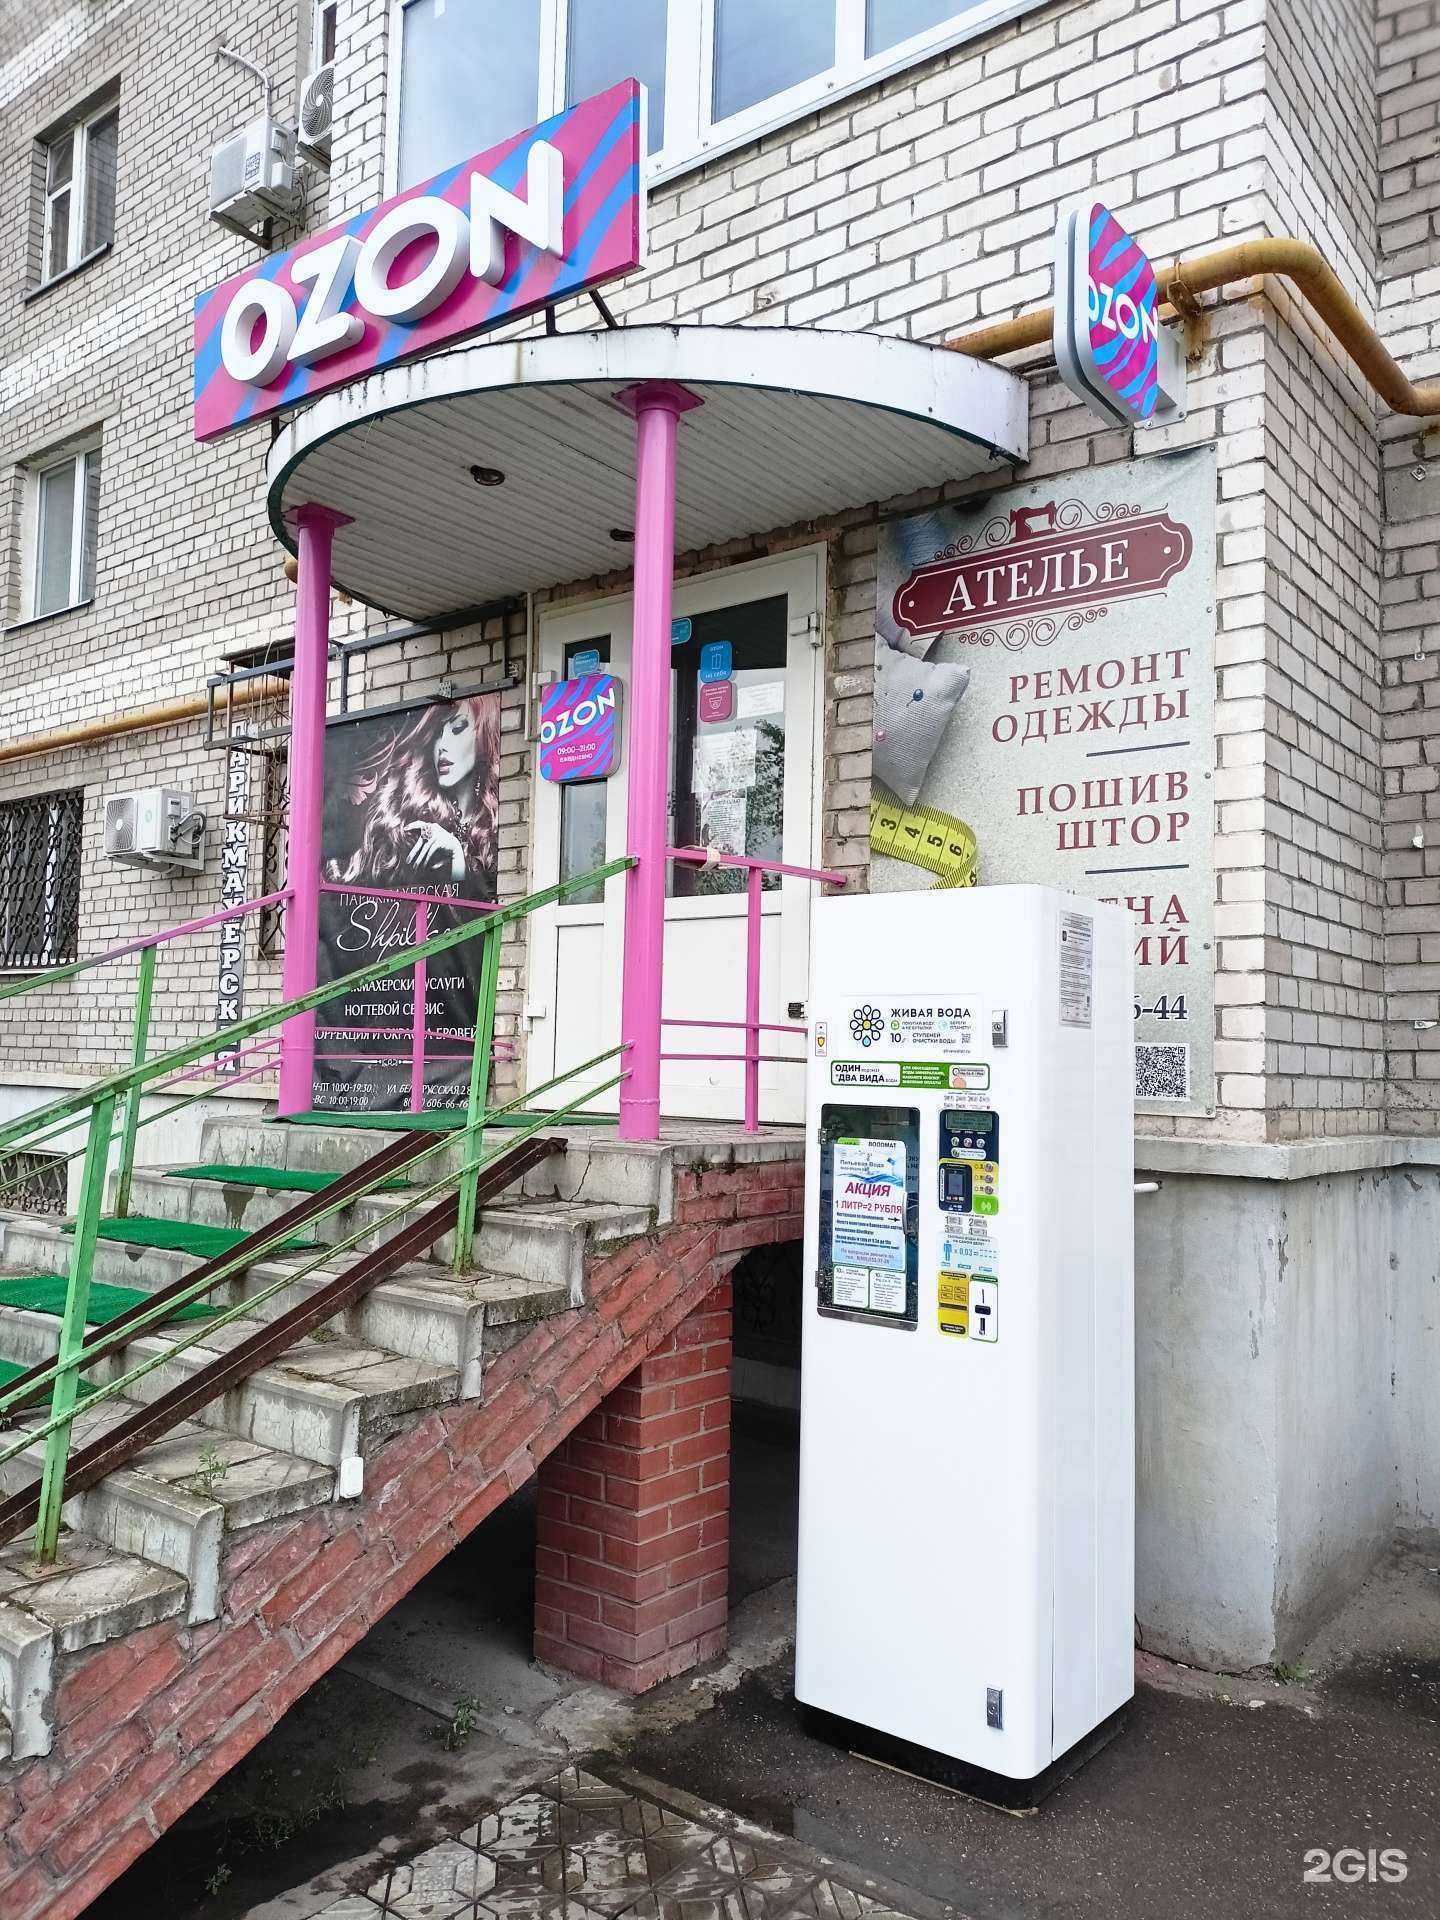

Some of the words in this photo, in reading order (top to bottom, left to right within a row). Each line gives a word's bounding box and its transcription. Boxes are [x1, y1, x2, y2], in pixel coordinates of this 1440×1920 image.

[220, 139, 564, 387] OZON
[942, 539, 1130, 615] АТЕЛЬЕ
[1009, 648, 1191, 704] РЕМОНТ
[540, 688, 616, 744] OZON
[991, 688, 1190, 746] ОДЕЖДЫ
[1016, 771, 1190, 816] ПОШИВ
[1055, 811, 1190, 851] ШТОР
[344, 1001, 400, 1016] НОГТЕВОЙ
[402, 1003, 445, 1016] СЕВИС
[891, 1008, 933, 1018] ЖИВАЯ
[937, 1008, 971, 1019] ВОДА
[890, 1032, 902, 1043] 10
[835, 1064, 861, 1073] ОДИН
[859, 1074, 885, 1083] ВИДА
[845, 1181, 891, 1198] АКЦИЯ
[840, 1200, 873, 1212] ЛИТР=2
[874, 1203, 903, 1215] РУБЛЯ
